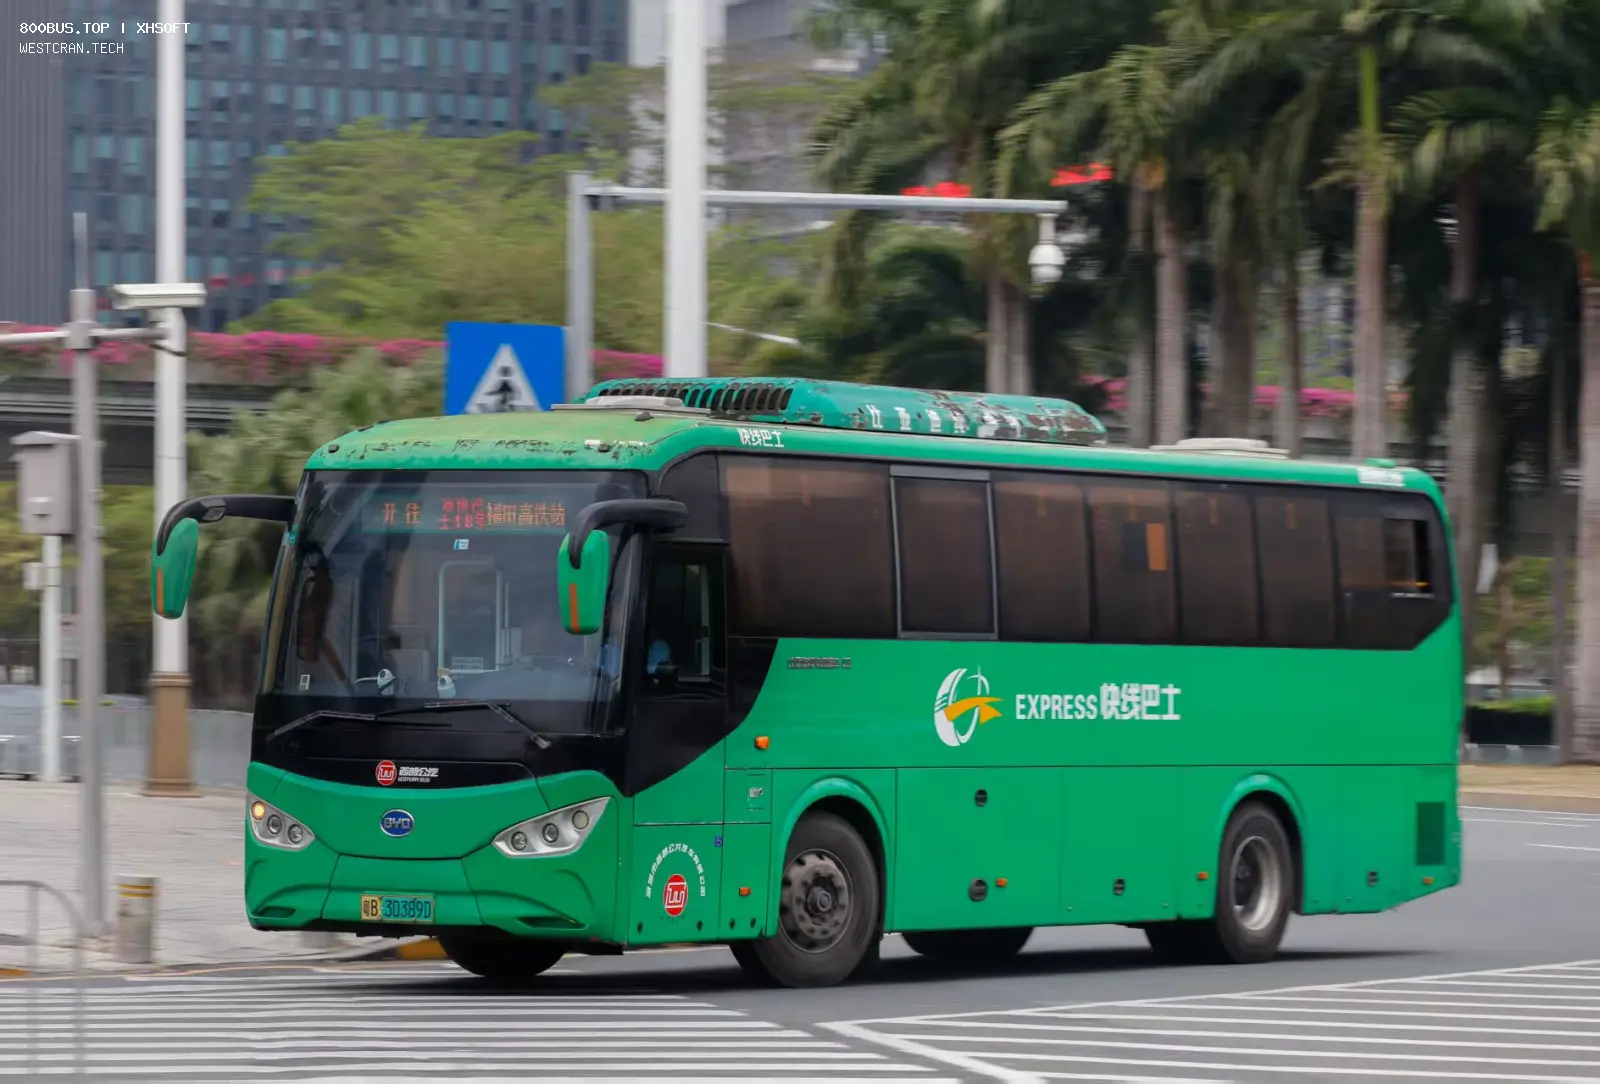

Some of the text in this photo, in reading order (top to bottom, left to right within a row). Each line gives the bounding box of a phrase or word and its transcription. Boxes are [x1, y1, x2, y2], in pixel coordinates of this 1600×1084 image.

[736, 428, 785, 447] 快线巴士
[1015, 682, 1182, 720] EXPRESS 快线巴士
[383, 817, 411, 829] BYD
